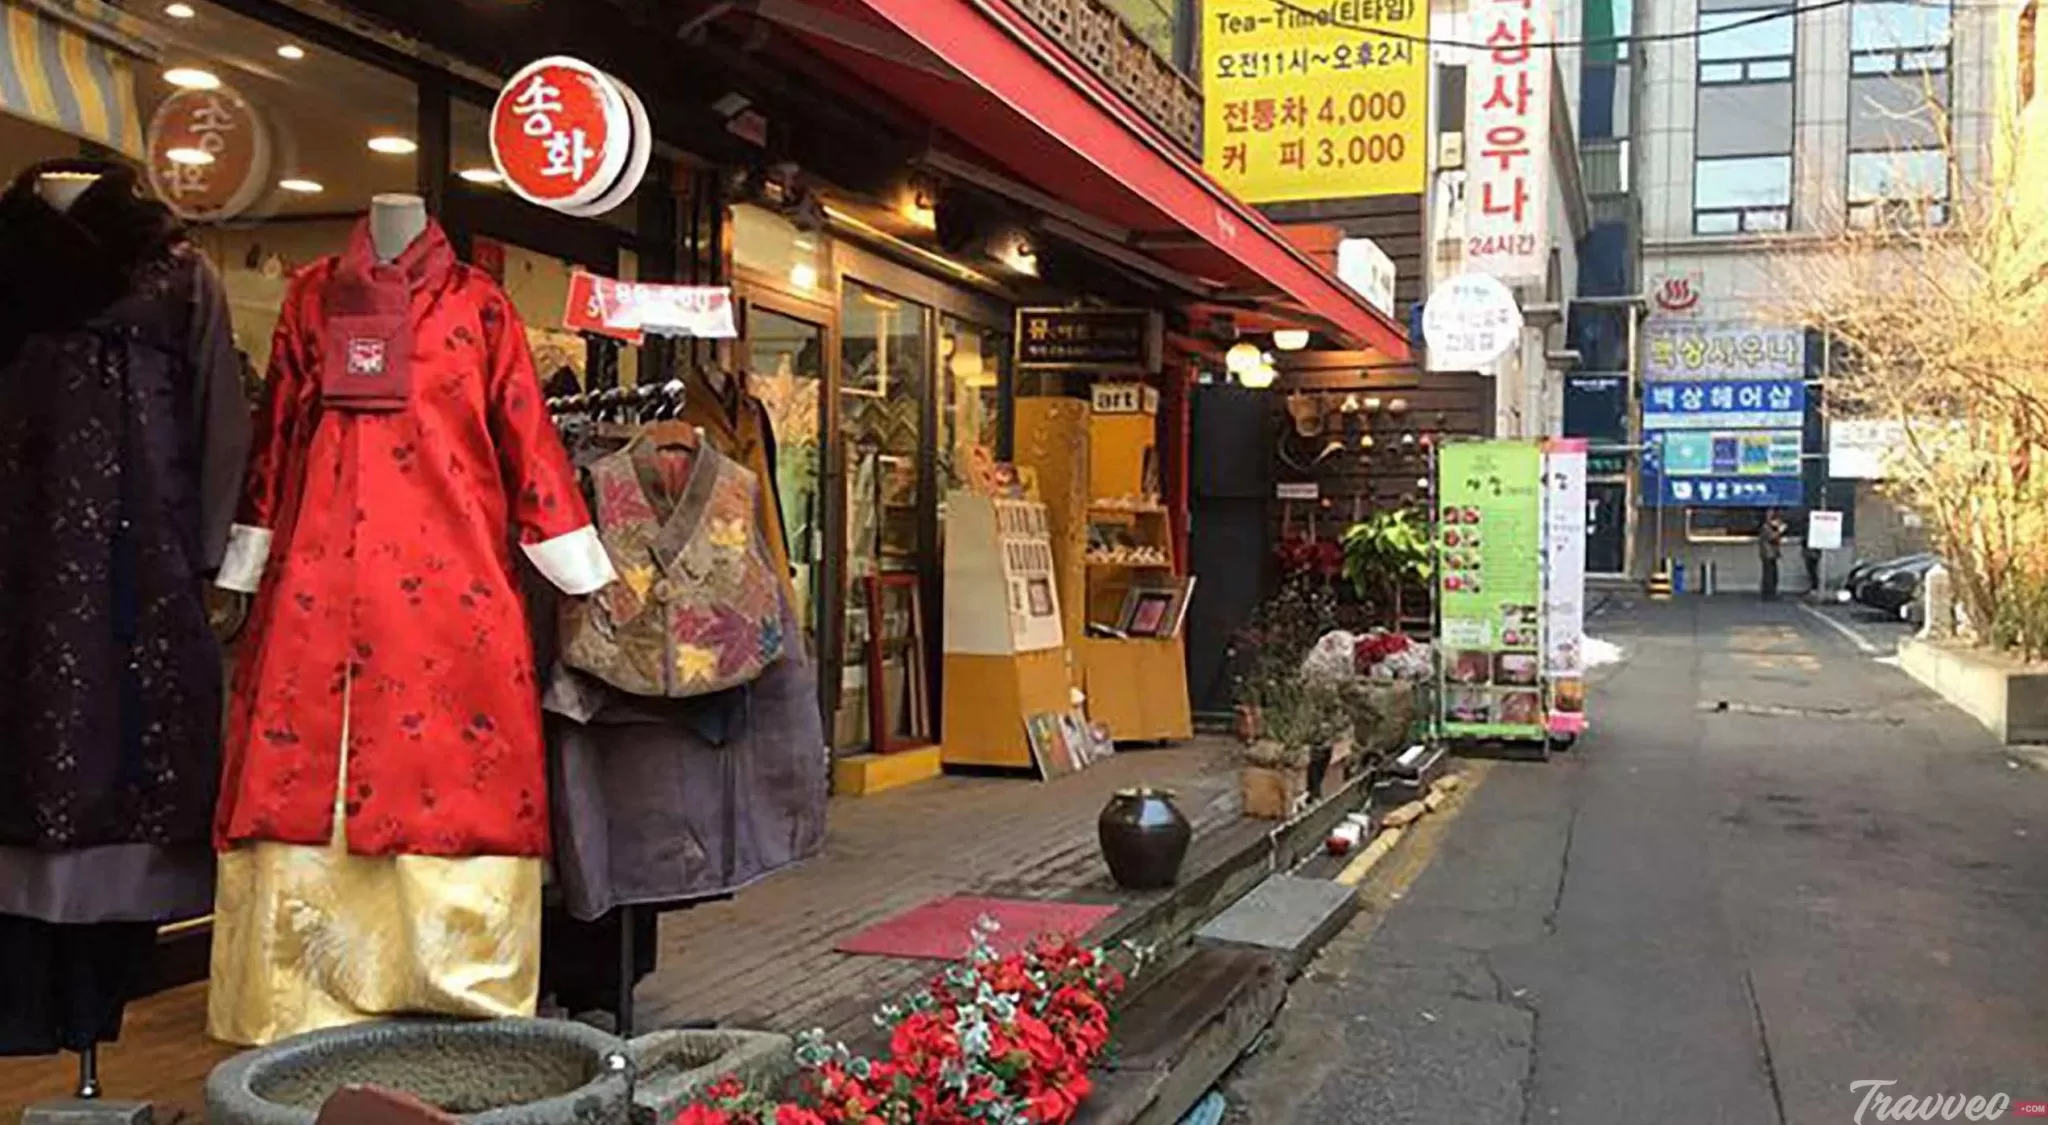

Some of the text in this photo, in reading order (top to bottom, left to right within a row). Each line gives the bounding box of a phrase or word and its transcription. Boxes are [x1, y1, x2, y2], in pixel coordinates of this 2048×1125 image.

[1216, 41, 1413, 78] 오전11시~오후2시
[512, 75, 595, 182] 송화
[1223, 91, 1406, 132] 전통차 4,000
[1317, 133, 1405, 167] 3,000
[1469, 236, 1534, 256] 24시간
[1098, 391, 1133, 408] art
